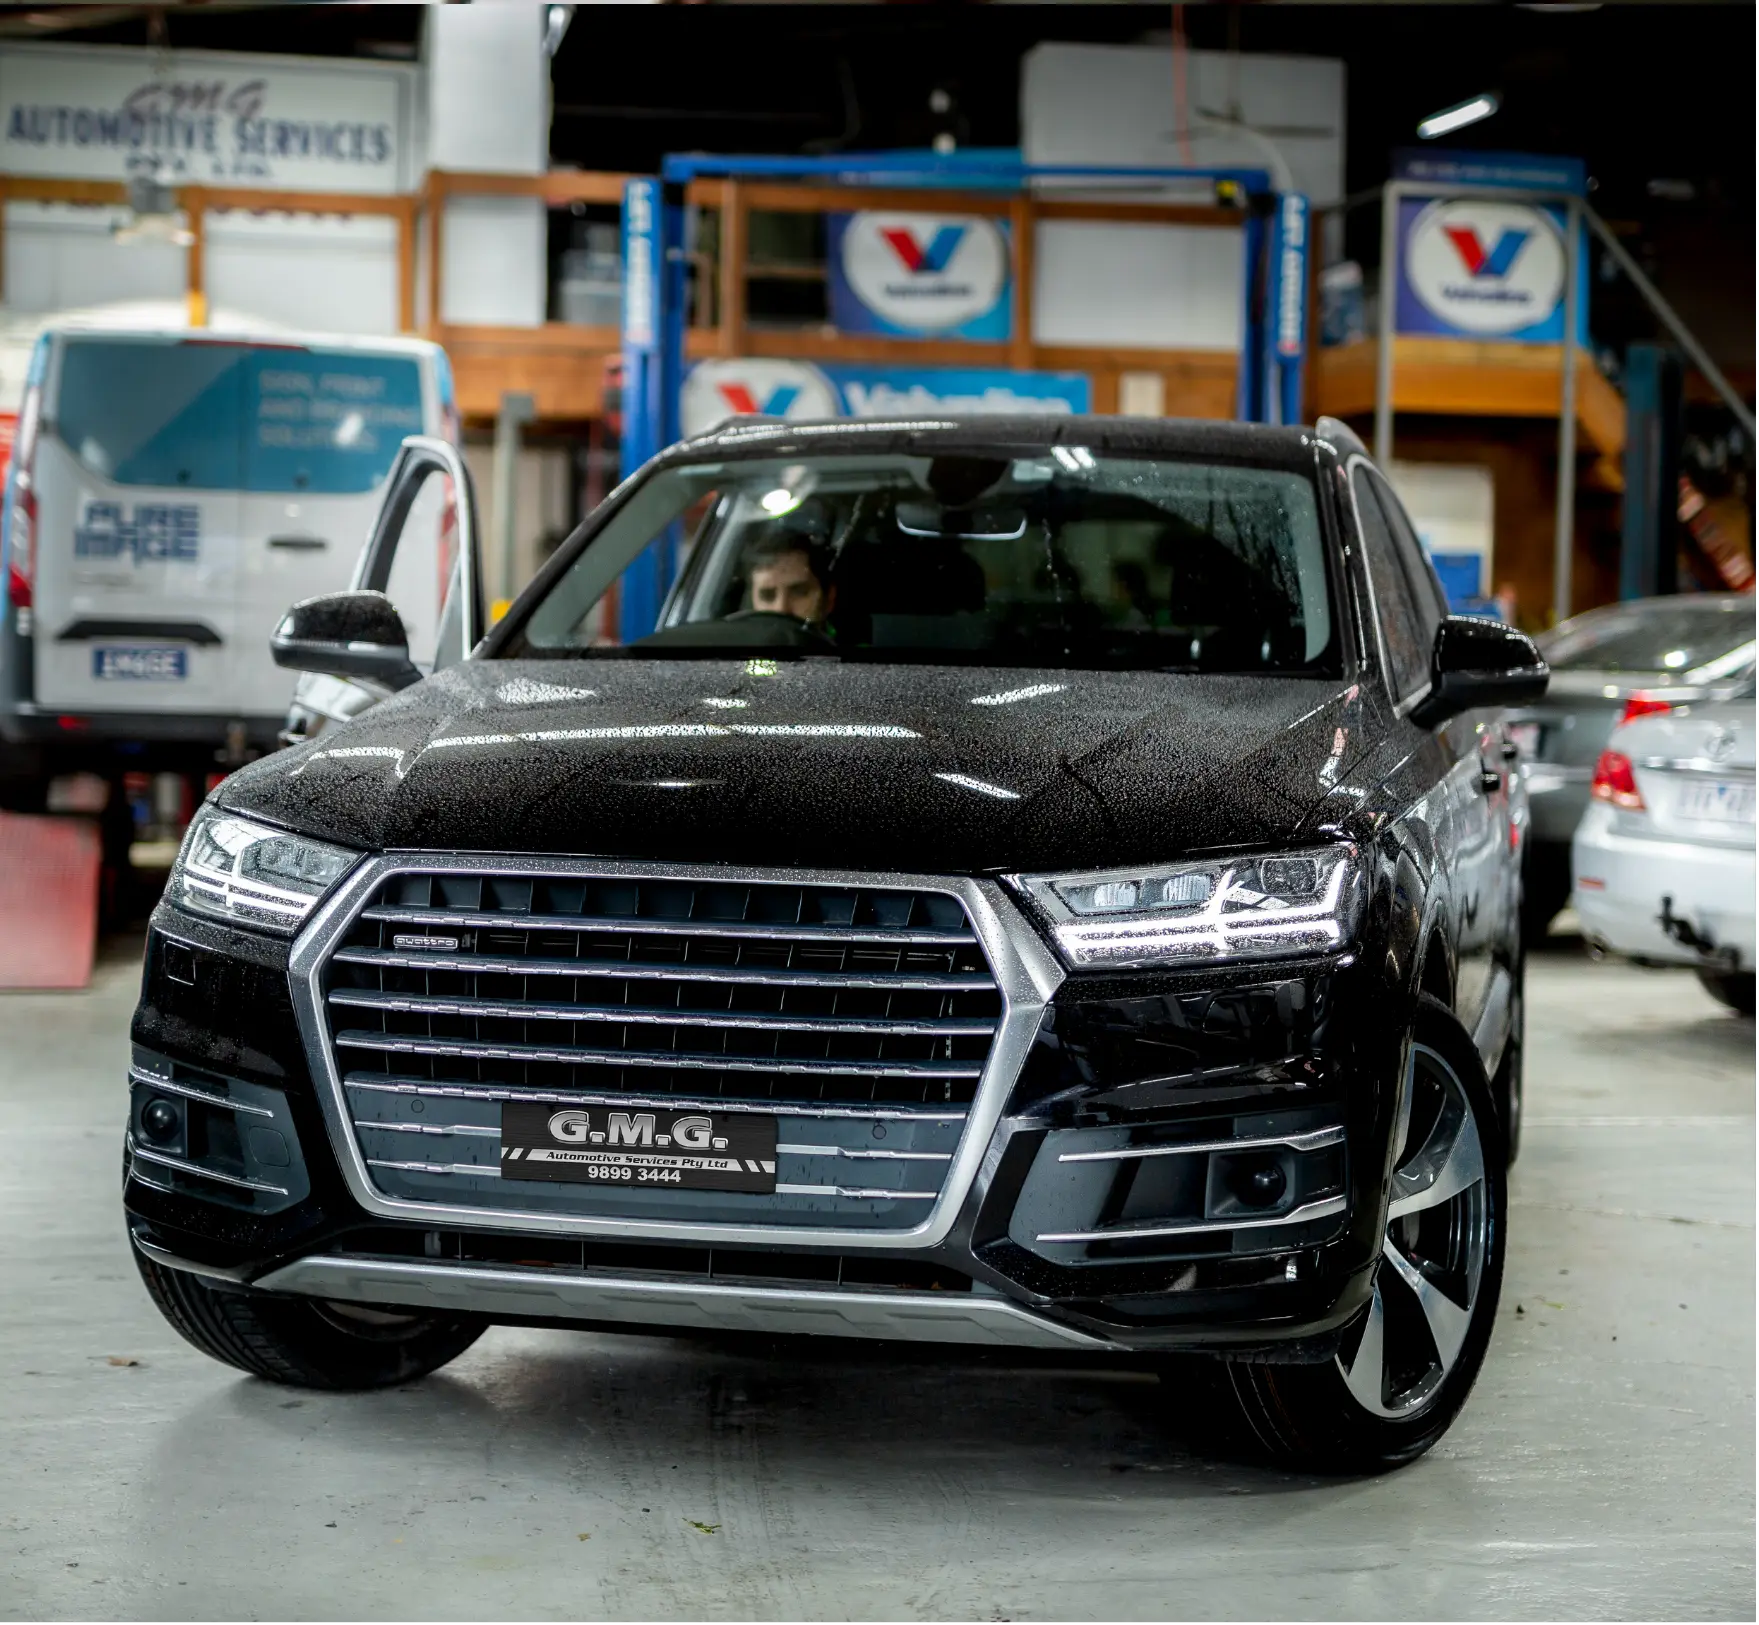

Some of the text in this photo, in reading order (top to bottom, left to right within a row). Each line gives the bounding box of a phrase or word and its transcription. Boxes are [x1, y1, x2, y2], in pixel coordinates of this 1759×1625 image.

[7, 104, 392, 164] AUTOMOTIVE SERVICES
[396, 937, 455, 946] quattro
[547, 1109, 729, 1151] G.M.G.
[546, 1151, 728, 1169] Automotive Services Pty Ltd
[587, 1165, 682, 1183] 9899 3444
